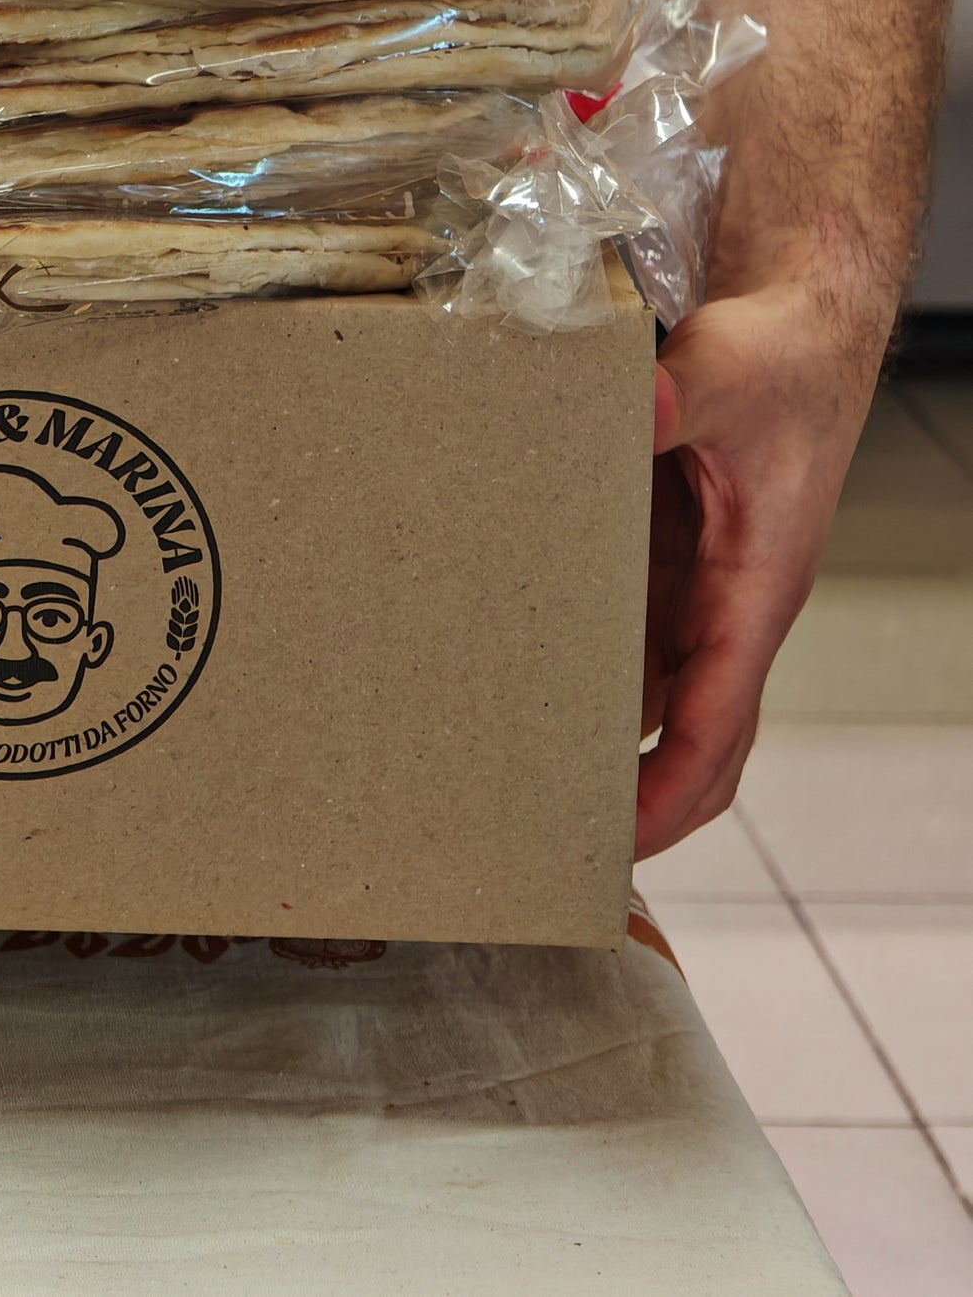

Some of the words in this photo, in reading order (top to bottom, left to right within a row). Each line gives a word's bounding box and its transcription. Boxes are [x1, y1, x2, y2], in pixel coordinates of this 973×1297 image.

[34, 407, 203, 574] MARINA
[83, 720, 118, 751] DA
[117, 662, 179, 735] FORNO
